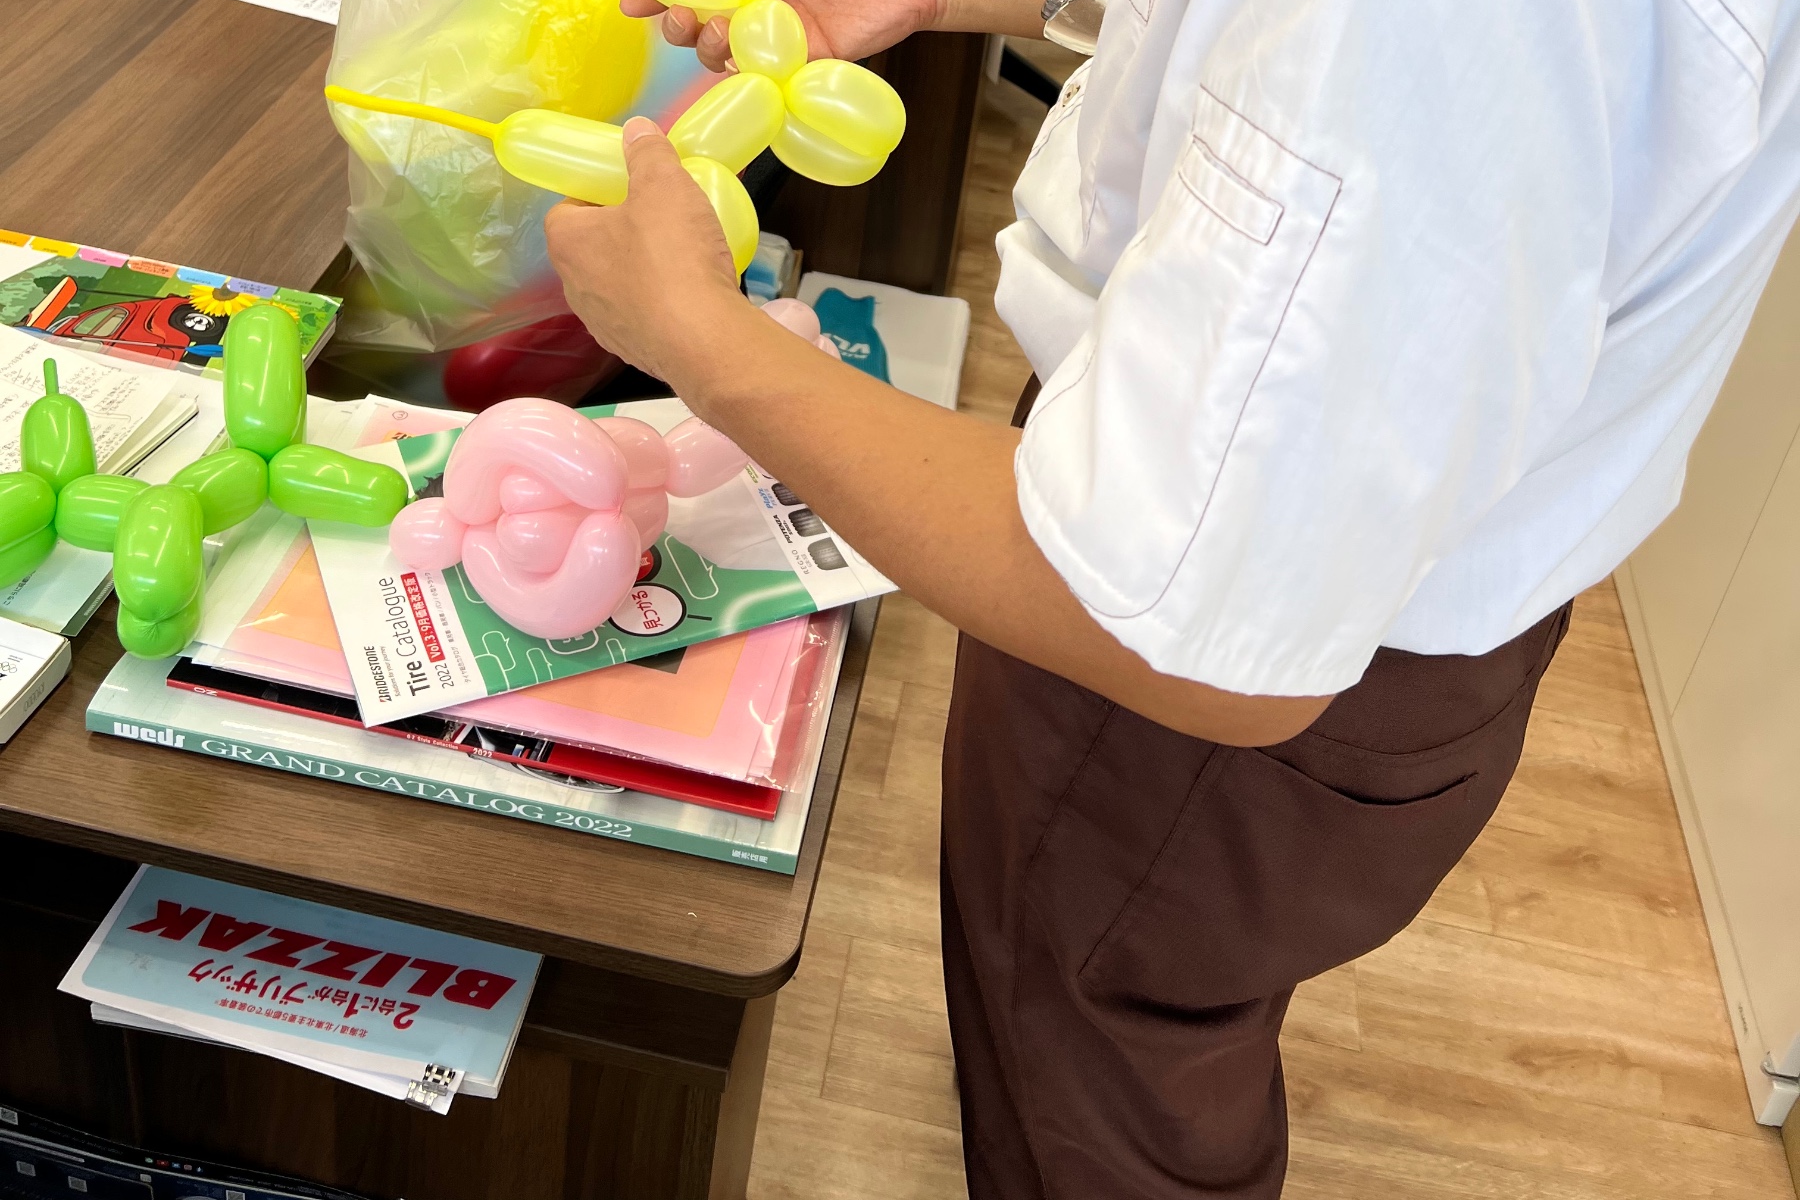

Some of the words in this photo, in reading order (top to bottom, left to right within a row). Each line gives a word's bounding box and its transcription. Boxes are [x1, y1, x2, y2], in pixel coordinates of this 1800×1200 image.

[773, 514, 793, 544] POTENZA
[791, 549, 810, 575] REGNO
[379, 576, 417, 657] Catalogue
[631, 590, 664, 630] 見つかる
[364, 645, 393, 703] BRIDGESTONE
[406, 660, 431, 697] Tire
[434, 663, 455, 690] 2022
[472, 747, 493, 759] 2022
[113, 722, 185, 748] weds
[201, 739, 346, 778] GRAND
[354, 771, 547, 820] CATALOG
[555, 811, 633, 839] 2022
[126, 899, 518, 1010] BLIZZAK
[187, 958, 421, 1030] 2台に1台がブリザック
